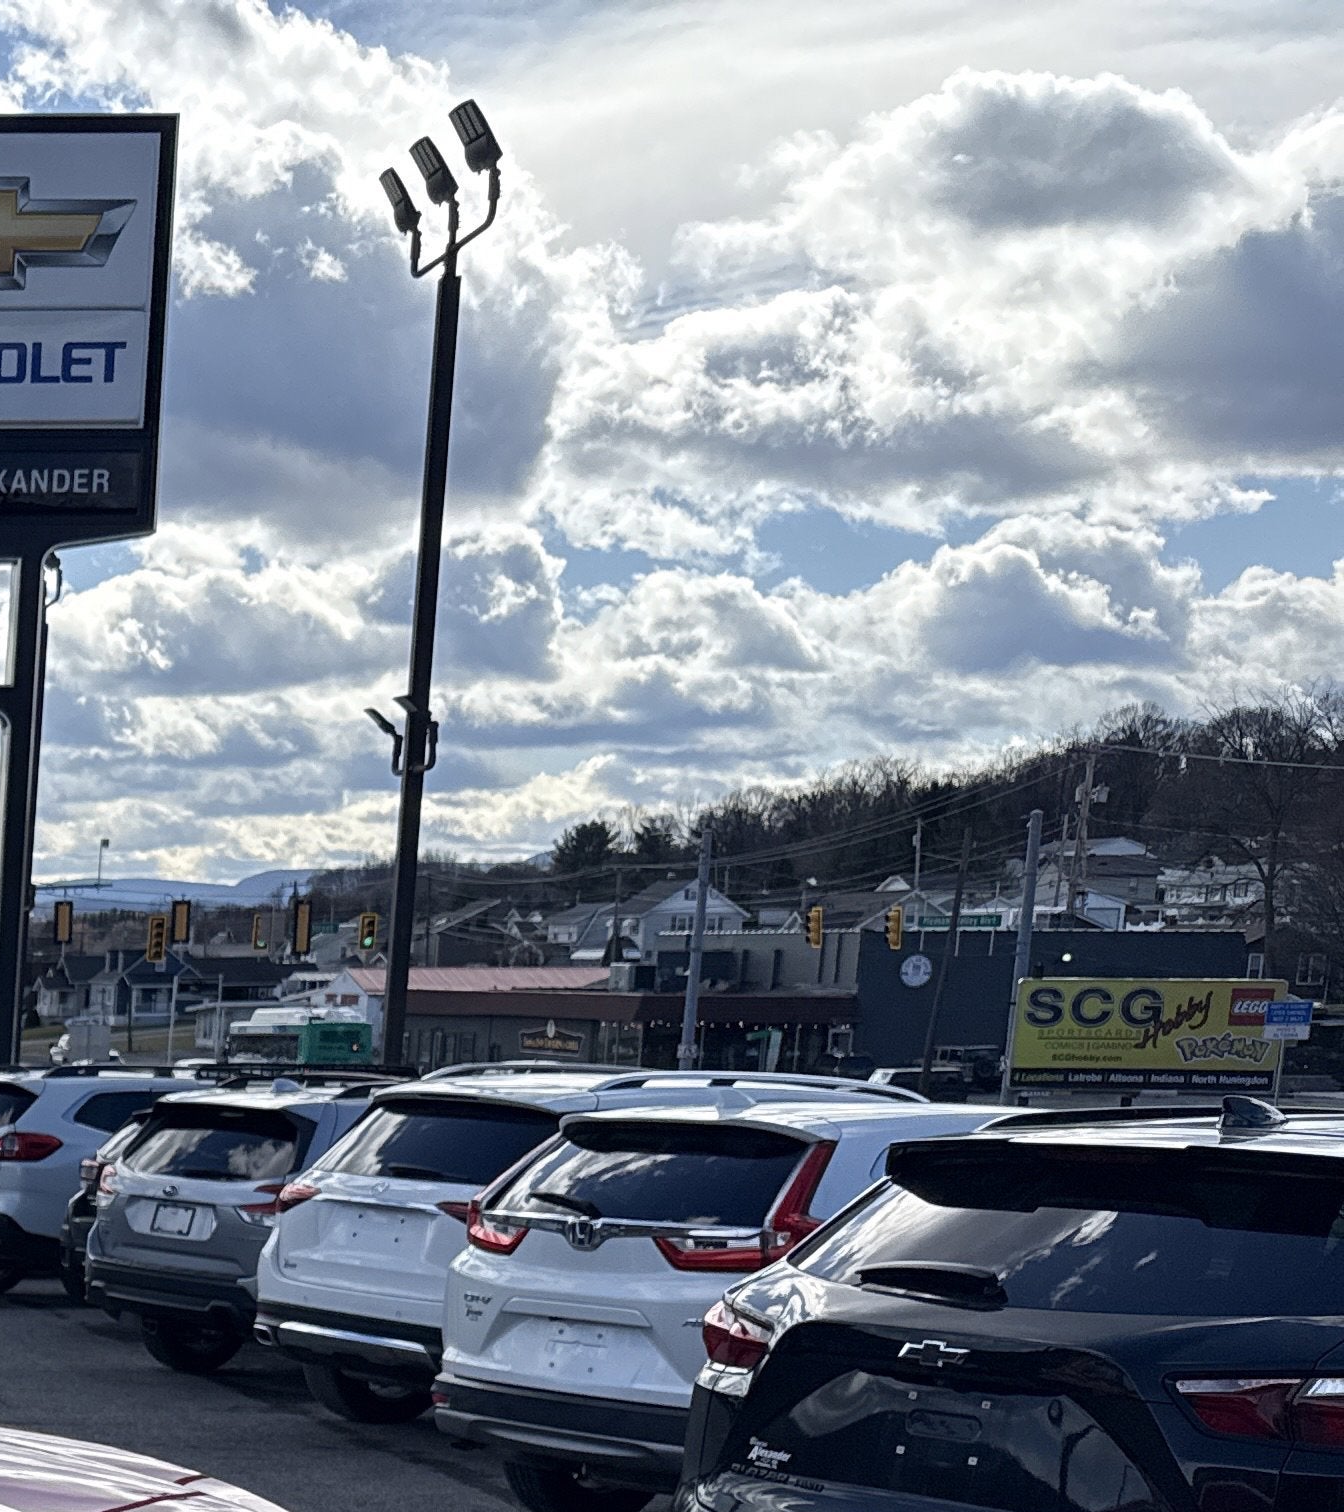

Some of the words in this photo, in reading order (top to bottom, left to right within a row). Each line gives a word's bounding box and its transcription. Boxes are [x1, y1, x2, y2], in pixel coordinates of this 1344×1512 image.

[1024, 987, 1162, 1028] SCG
[1231, 1000, 1268, 1016] LEGO
[1133, 991, 1214, 1049] Hobby
[1038, 1028, 1143, 1038] SPORTSCARDS
[1044, 1041, 1084, 1050] COMICS
[1068, 1072, 1103, 1082] Latrobe
[1108, 1073, 1144, 1083] Altoona
[1150, 1074, 1185, 1083] Indiana
[1191, 1075, 1217, 1084] North
